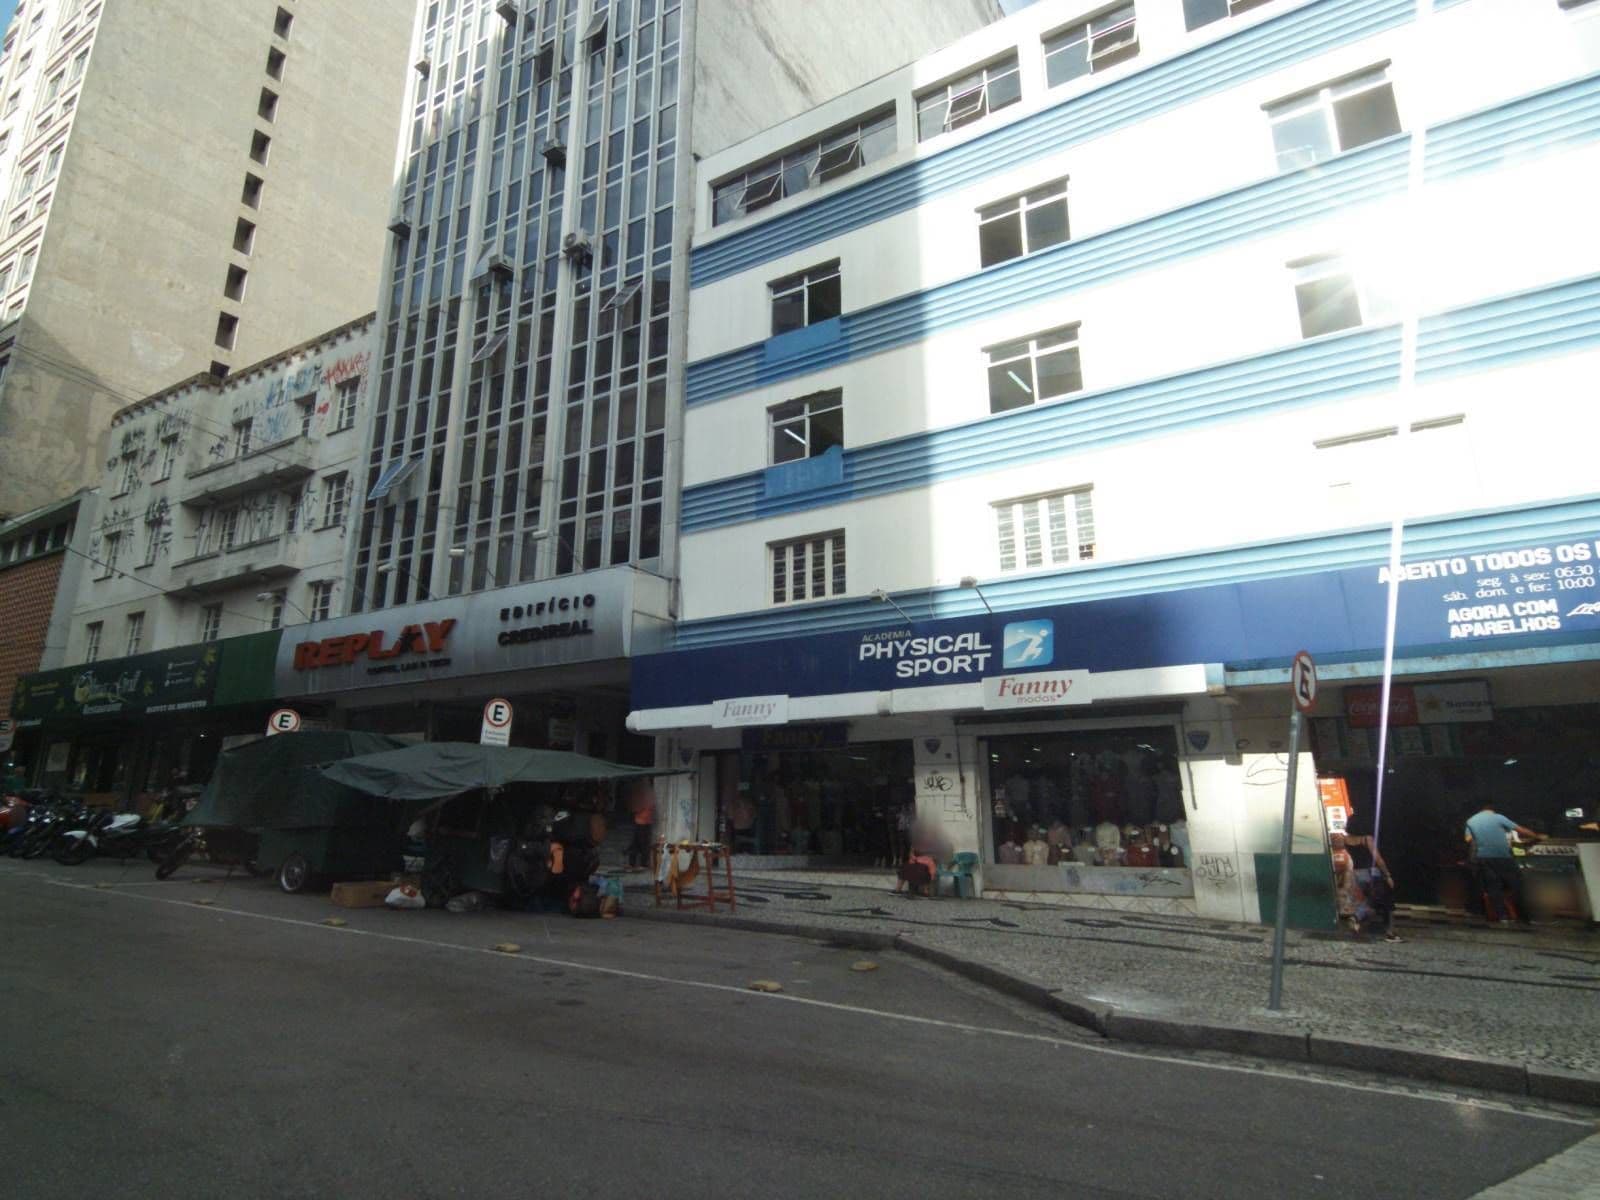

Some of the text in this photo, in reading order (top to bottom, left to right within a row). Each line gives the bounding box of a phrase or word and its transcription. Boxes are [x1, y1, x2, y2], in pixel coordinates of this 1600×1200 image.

[1470, 547, 1552, 572] TODOS
[1556, 543, 1591, 562] OS
[1554, 565, 1594, 578] 06:30
[1557, 577, 1595, 590] 10:00
[1448, 604, 1510, 623] AGORA
[1513, 599, 1558, 616] COM
[862, 630, 912, 642] ACADEMIA
[1450, 616, 1560, 639] APARELHOS
[293, 619, 456, 672] REPLAY
[859, 632, 992, 661] PHYSICAL
[896, 653, 992, 678] SPORT
[998, 678, 1072, 698] Fanny
[1017, 694, 1056, 704] modas
[493, 704, 504, 721] E
[722, 701, 776, 717] Fanny
[279, 714, 291, 728] E
